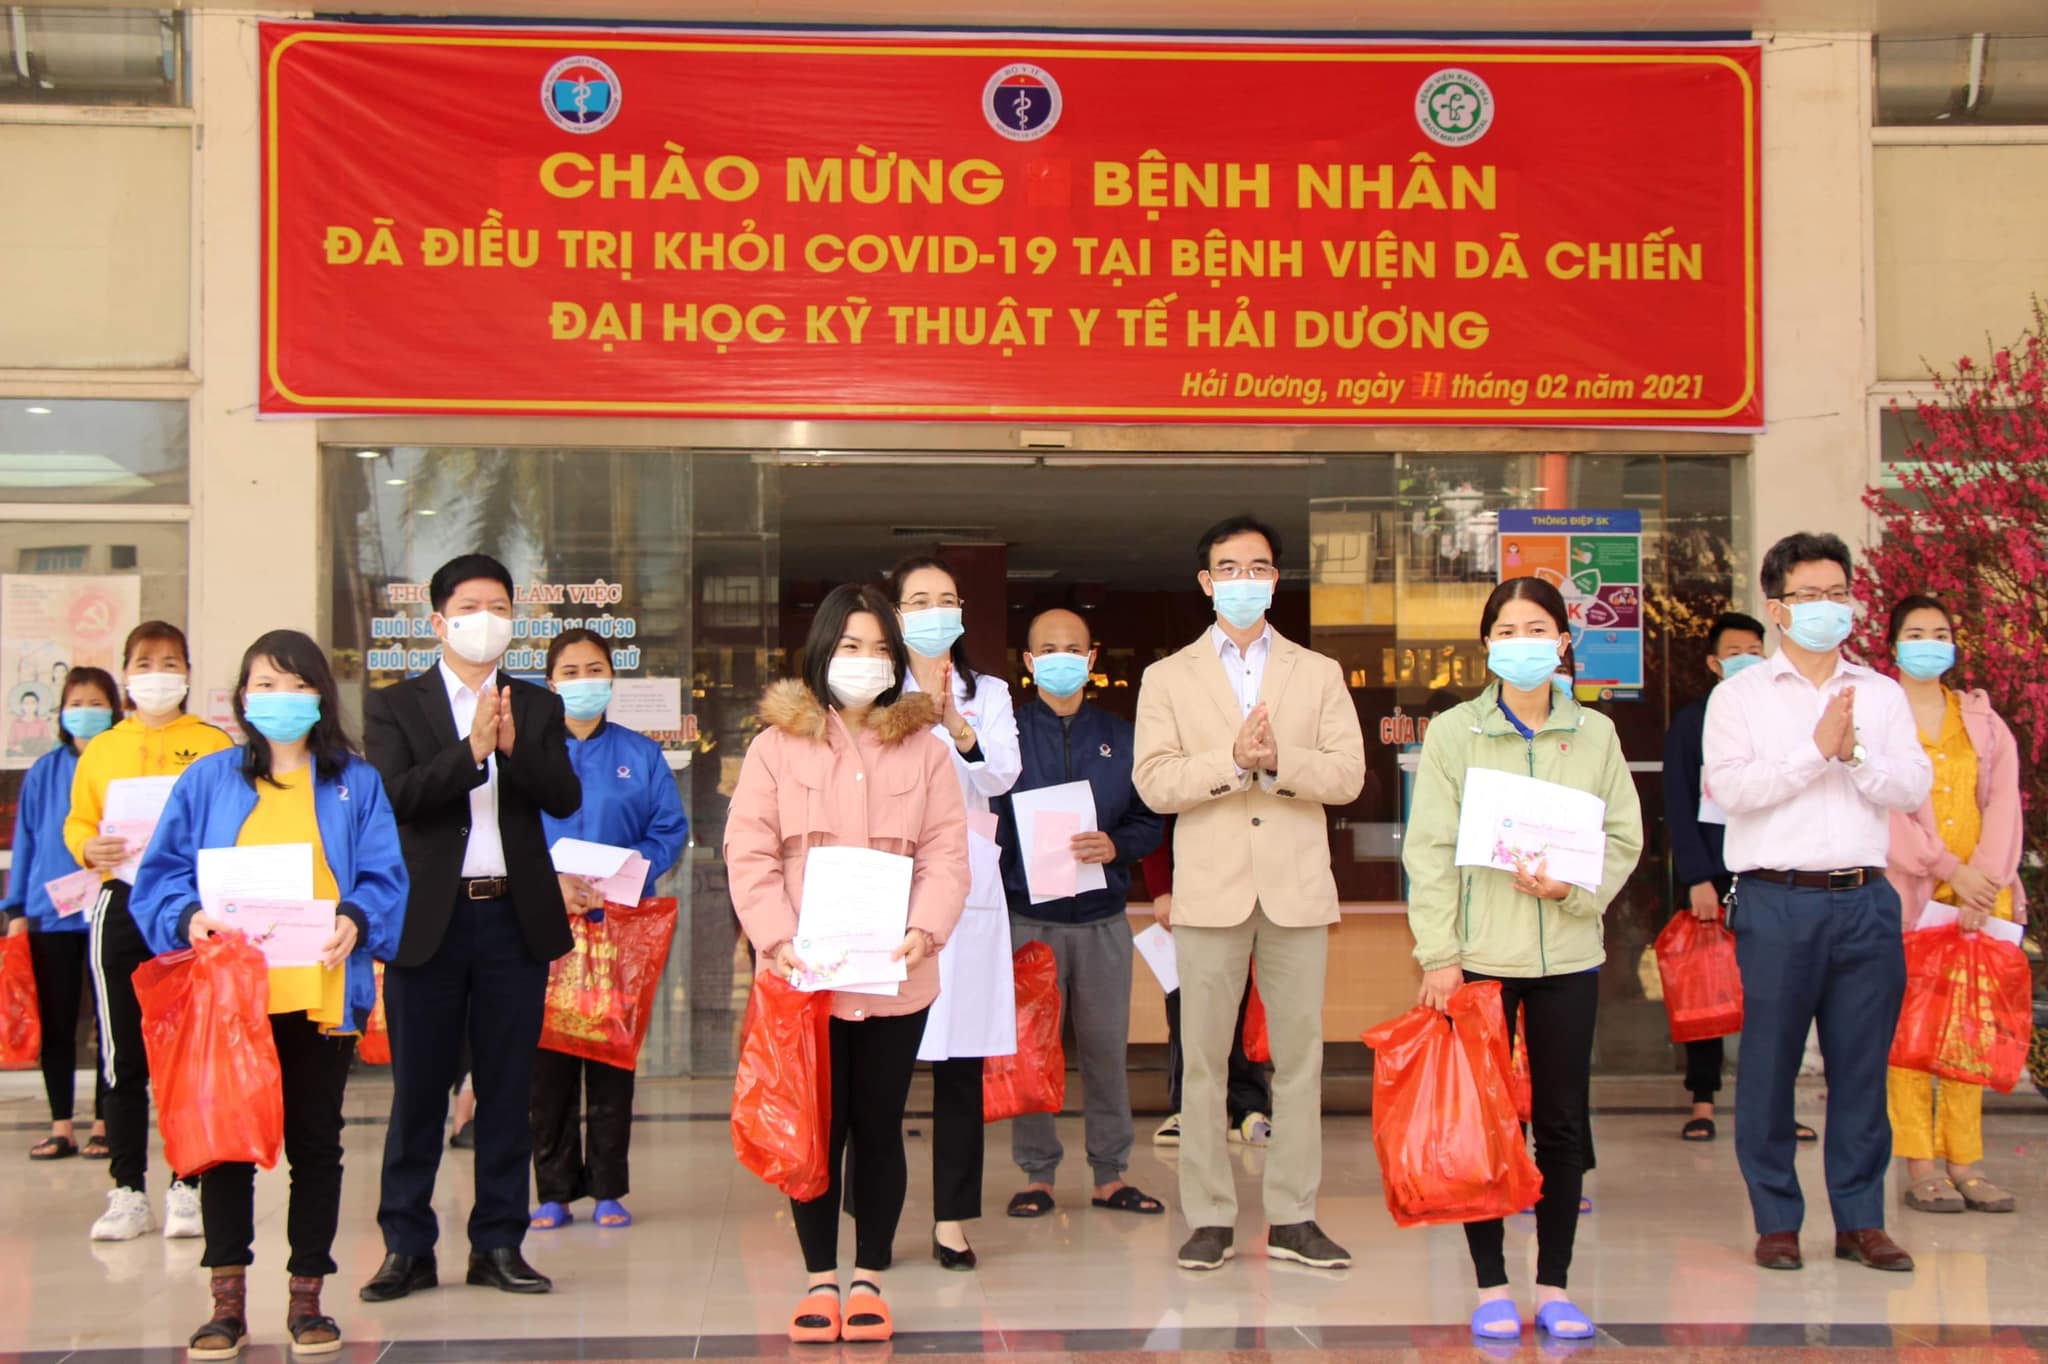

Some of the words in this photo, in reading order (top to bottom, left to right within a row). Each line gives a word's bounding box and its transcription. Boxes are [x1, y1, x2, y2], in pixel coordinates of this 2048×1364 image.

[540, 142, 760, 203] CHÀO
[787, 145, 1005, 206] MỪNG
[1094, 148, 1270, 221] BỆNH
[1298, 151, 1497, 210] NHÂN
[324, 218, 403, 267] ĐÃ
[421, 208, 540, 268] ĐIỀU
[558, 230, 633, 281] TRỊ
[655, 219, 785, 272] KHỎI
[805, 234, 1057, 275] COVID-19
[1073, 238, 1151, 288] TẠI
[1172, 228, 1303, 289] BỆNH
[1322, 230, 1436, 290] VIỆN
[1456, 232, 1528, 280] DÃ
[1546, 226, 1703, 281] CHIẾN
[549, 301, 642, 353] ĐẠI
[663, 303, 786, 354] HỌC
[807, 296, 872, 345] KỸ
[888, 296, 1053, 357] THUẬT
[1070, 309, 1099, 347] Y
[1117, 293, 1178, 348] TẾ
[1187, 297, 1276, 349] HẢI
[1295, 306, 1490, 351] DƯƠNG
[1182, 368, 1228, 397] Hải
[1234, 373, 1327, 405] Dương,
[1336, 371, 1405, 405] ngày
[1420, 371, 1444, 398] 11
[1451, 371, 1528, 406] tháng
[1536, 374, 1569, 399] 02
[1575, 374, 1635, 399] năm
[1642, 375, 1703, 400] 2021
[514, 581, 564, 604] LÀM
[566, 578, 623, 608] VIỆC
[1567, 603, 1582, 619] K
[614, 617, 636, 639] 30
[1381, 706, 1416, 744] CỬA
